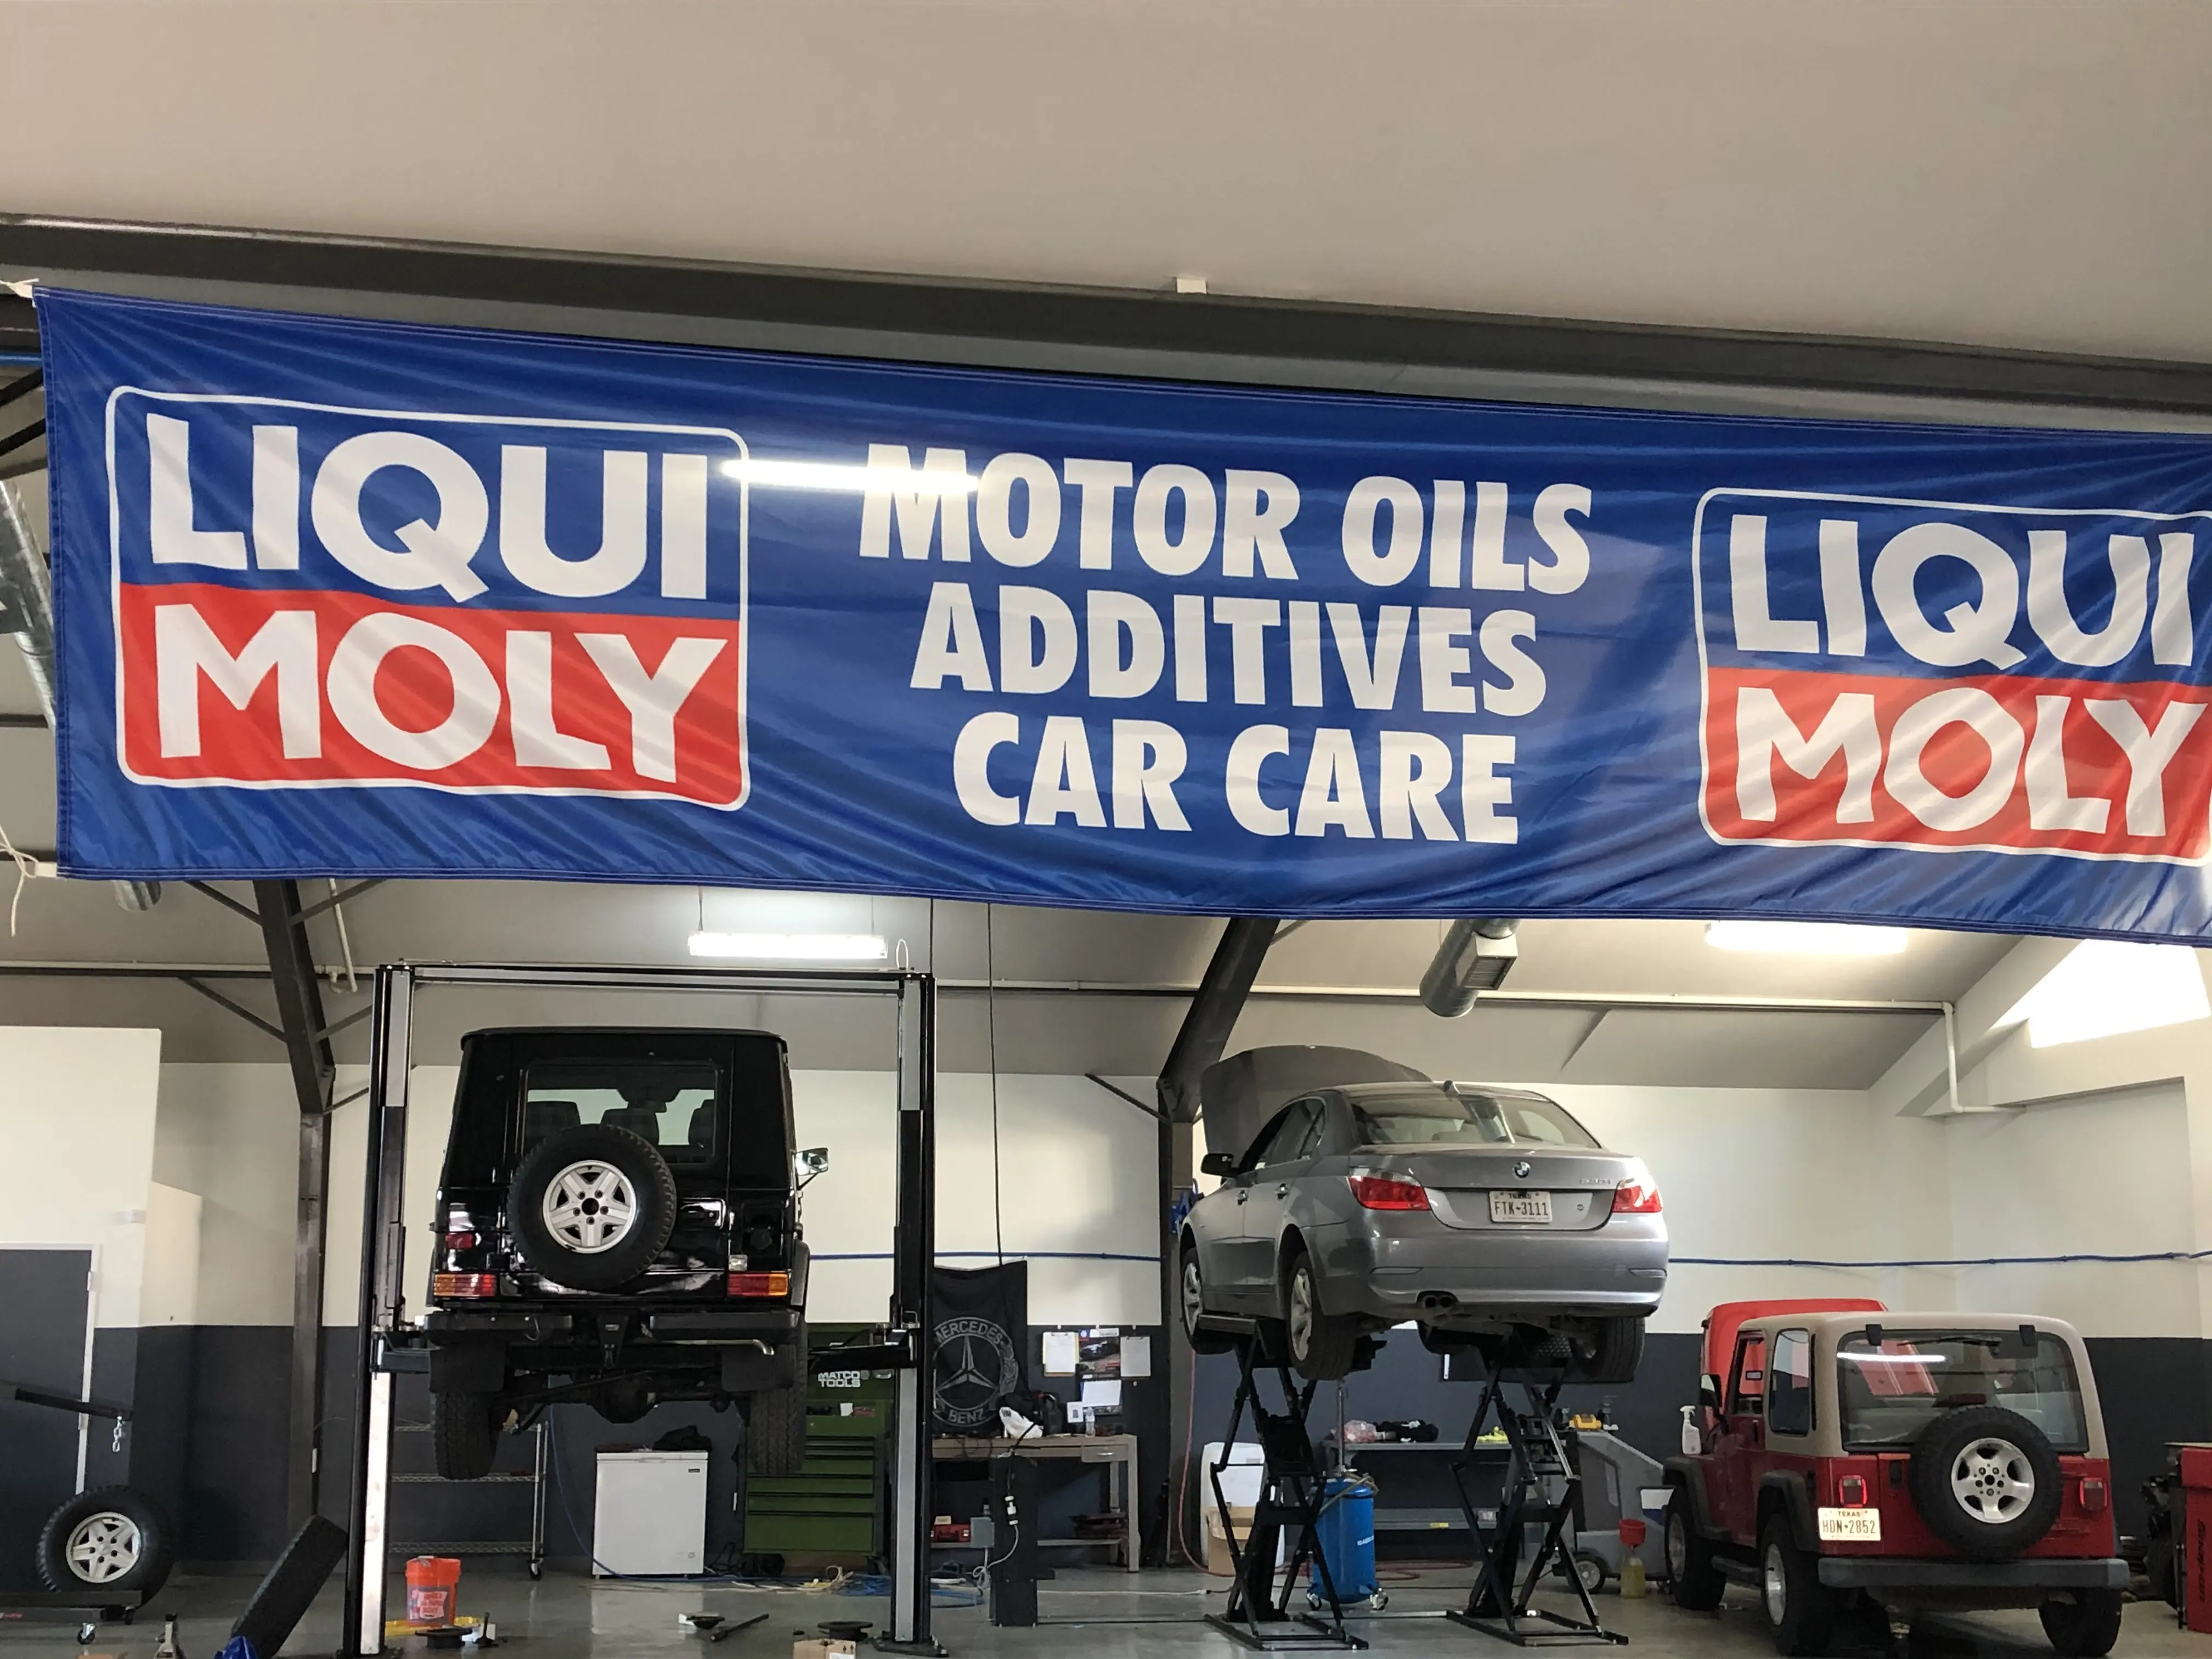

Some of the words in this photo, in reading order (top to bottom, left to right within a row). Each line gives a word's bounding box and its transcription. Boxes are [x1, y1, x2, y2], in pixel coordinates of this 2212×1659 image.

[146, 413, 707, 603] LIQUI
[860, 444, 1300, 579] MOTOR
[1342, 476, 1591, 594] OILS
[910, 582, 1546, 716] ADDITIVES
[1730, 514, 2194, 670] LIQUI
[155, 603, 728, 783] MOLY
[1735, 687, 2209, 836] MOLY
[953, 712, 1192, 832] CAR
[1226, 724, 1518, 844] CARE
[817, 1371, 860, 1381] MATCO
[820, 1379, 861, 1387] TOOLS
[947, 1408, 986, 1423] BENZ
